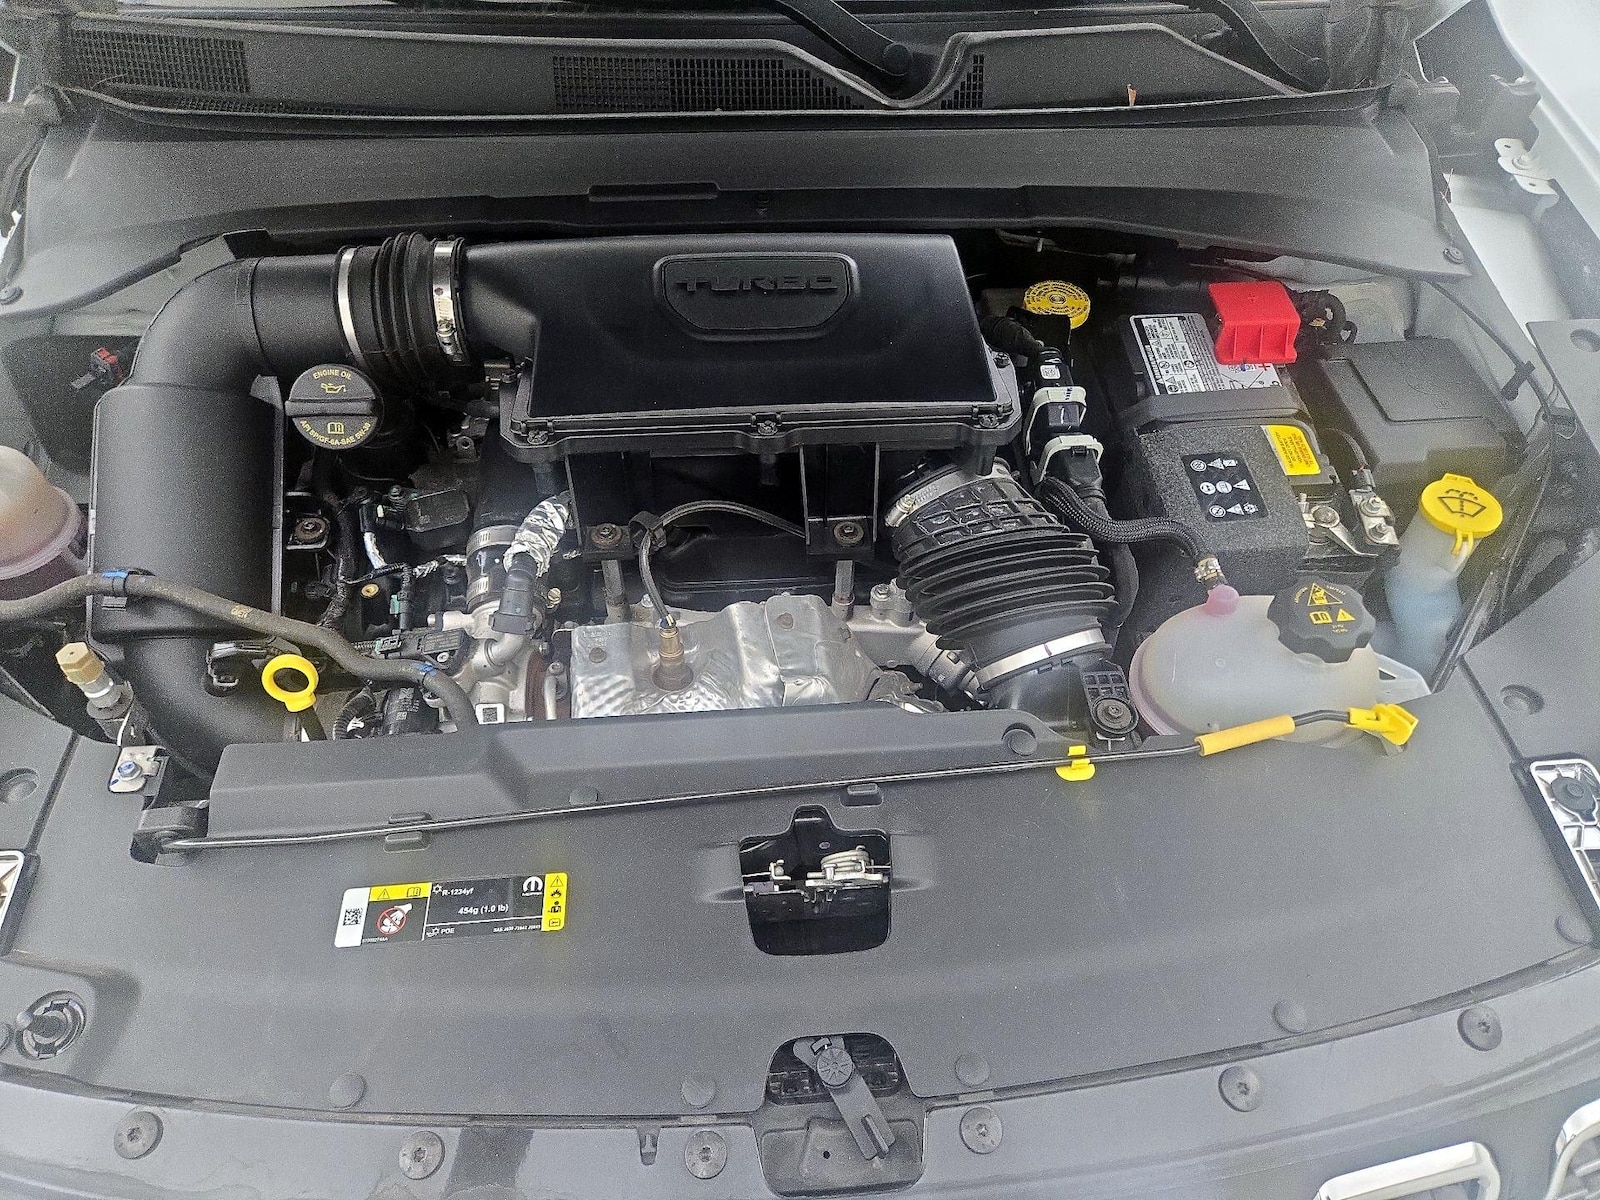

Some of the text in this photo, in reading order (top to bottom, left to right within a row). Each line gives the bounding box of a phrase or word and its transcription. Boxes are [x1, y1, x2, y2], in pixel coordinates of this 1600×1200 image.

[676, 276, 838, 292] TURBO
[312, 369, 352, 381] ENGINE OIL
[300, 420, 310, 432] API
[441, 887, 474, 897] R-1234yf
[458, 903, 509, 916] 454g (1.0 lb)
